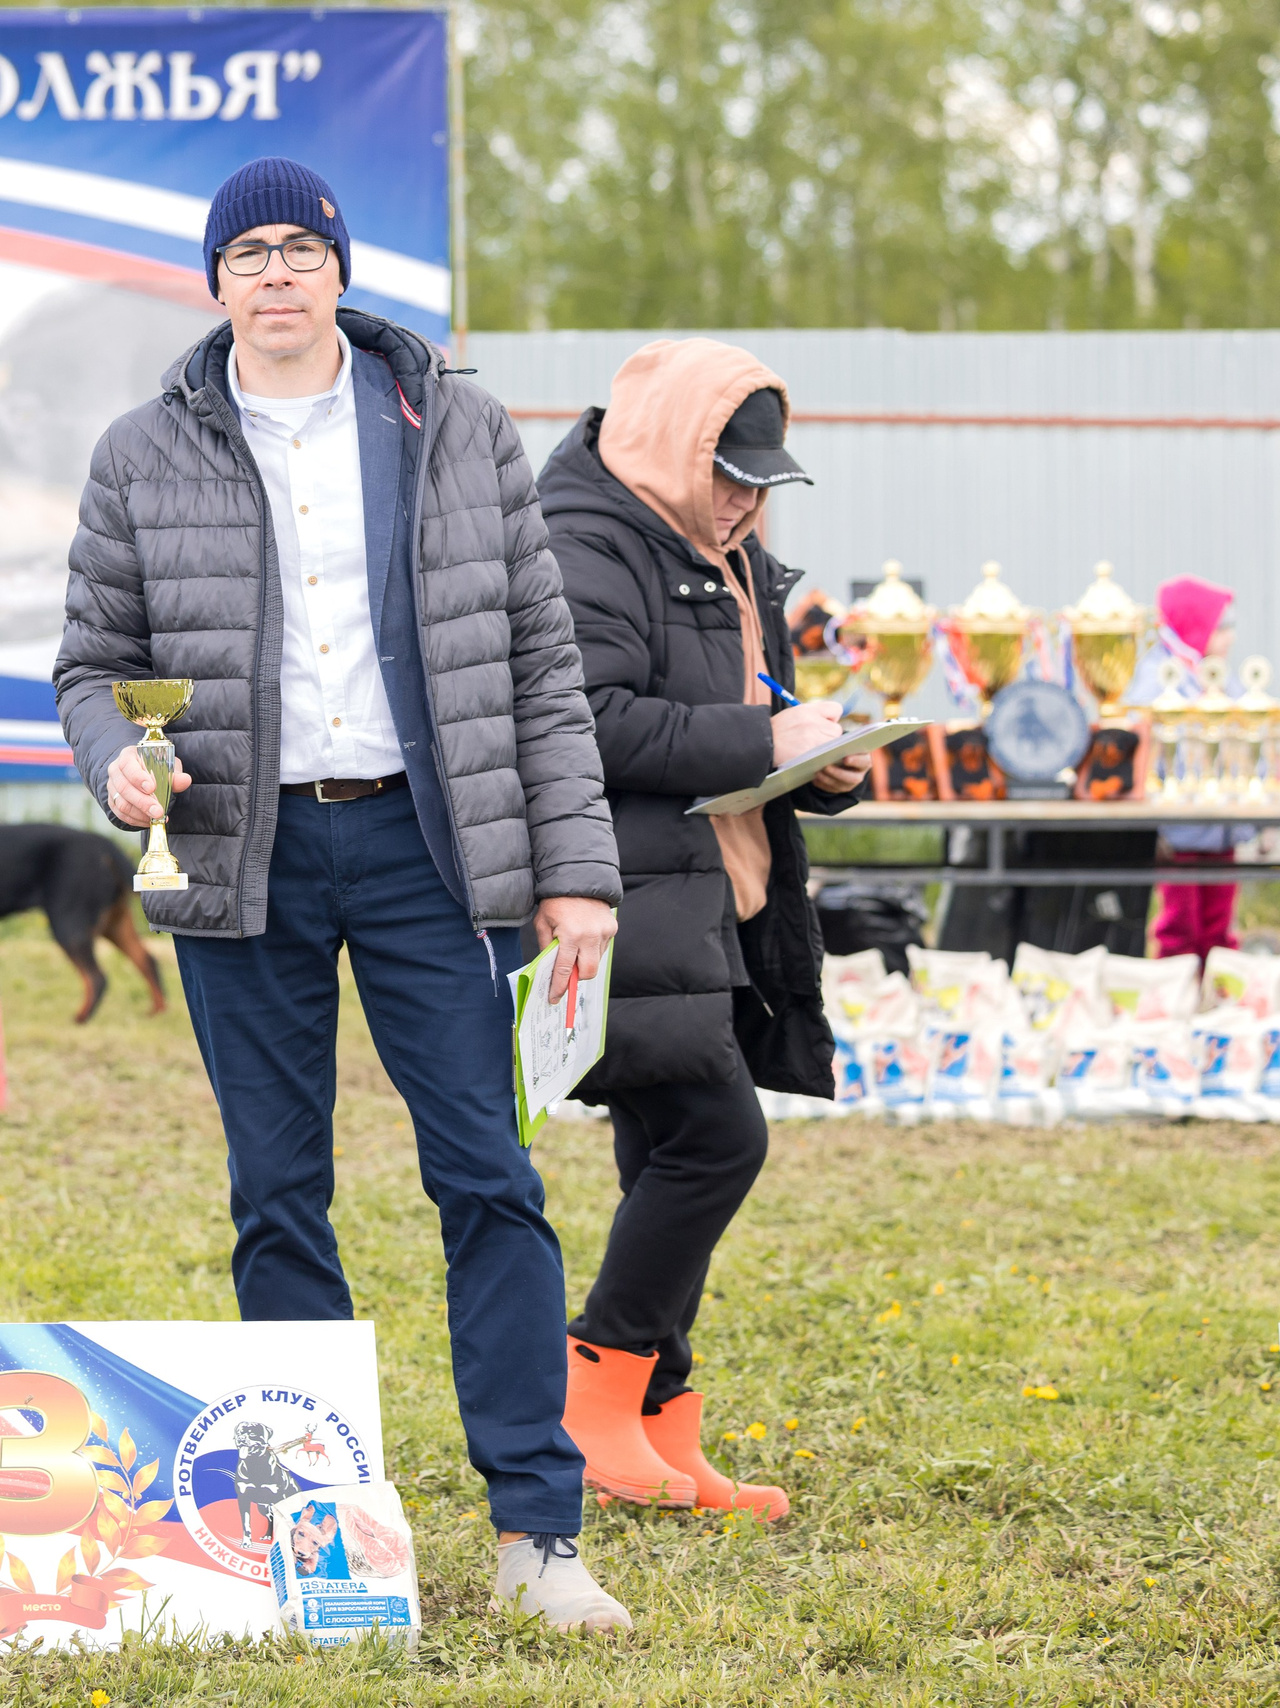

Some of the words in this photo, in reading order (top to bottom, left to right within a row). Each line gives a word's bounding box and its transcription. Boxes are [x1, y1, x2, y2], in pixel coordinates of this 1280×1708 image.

[178, 1394, 247, 1496] РОТВЕЙЛЕР
[261, 1390, 317, 1411] КЛУБ
[325, 1412, 371, 1484] РОССИ
